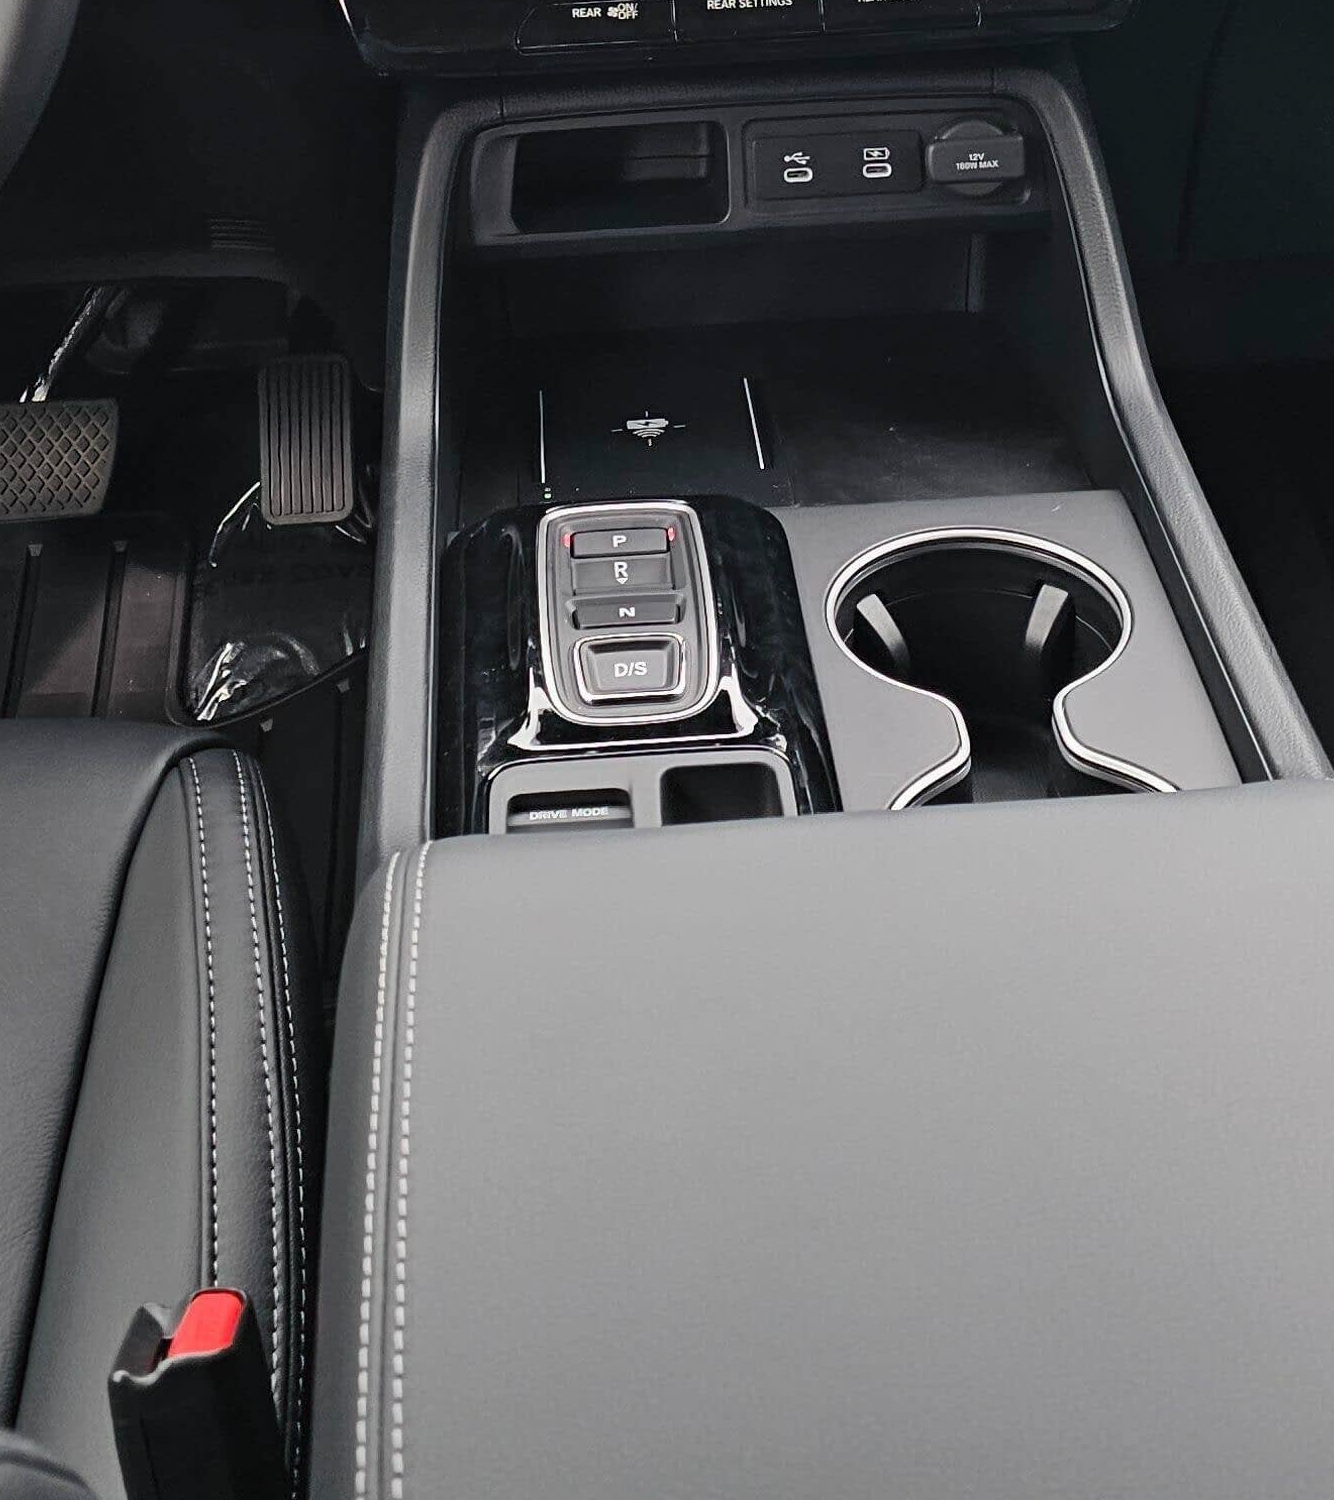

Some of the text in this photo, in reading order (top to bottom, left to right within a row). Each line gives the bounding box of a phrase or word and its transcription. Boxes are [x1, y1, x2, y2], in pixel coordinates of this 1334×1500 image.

[707, 0, 737, 10] REAR
[572, 7, 601, 19] REAR
[618, 11, 638, 20] OFF
[969, 153, 985, 161] 12V
[979, 160, 999, 168] MAX
[612, 535, 627, 548] P
[614, 561, 629, 578] R
[619, 607, 636, 618] N
[614, 661, 648, 677] D/S
[529, 806, 609, 820] DRIVE MODE
